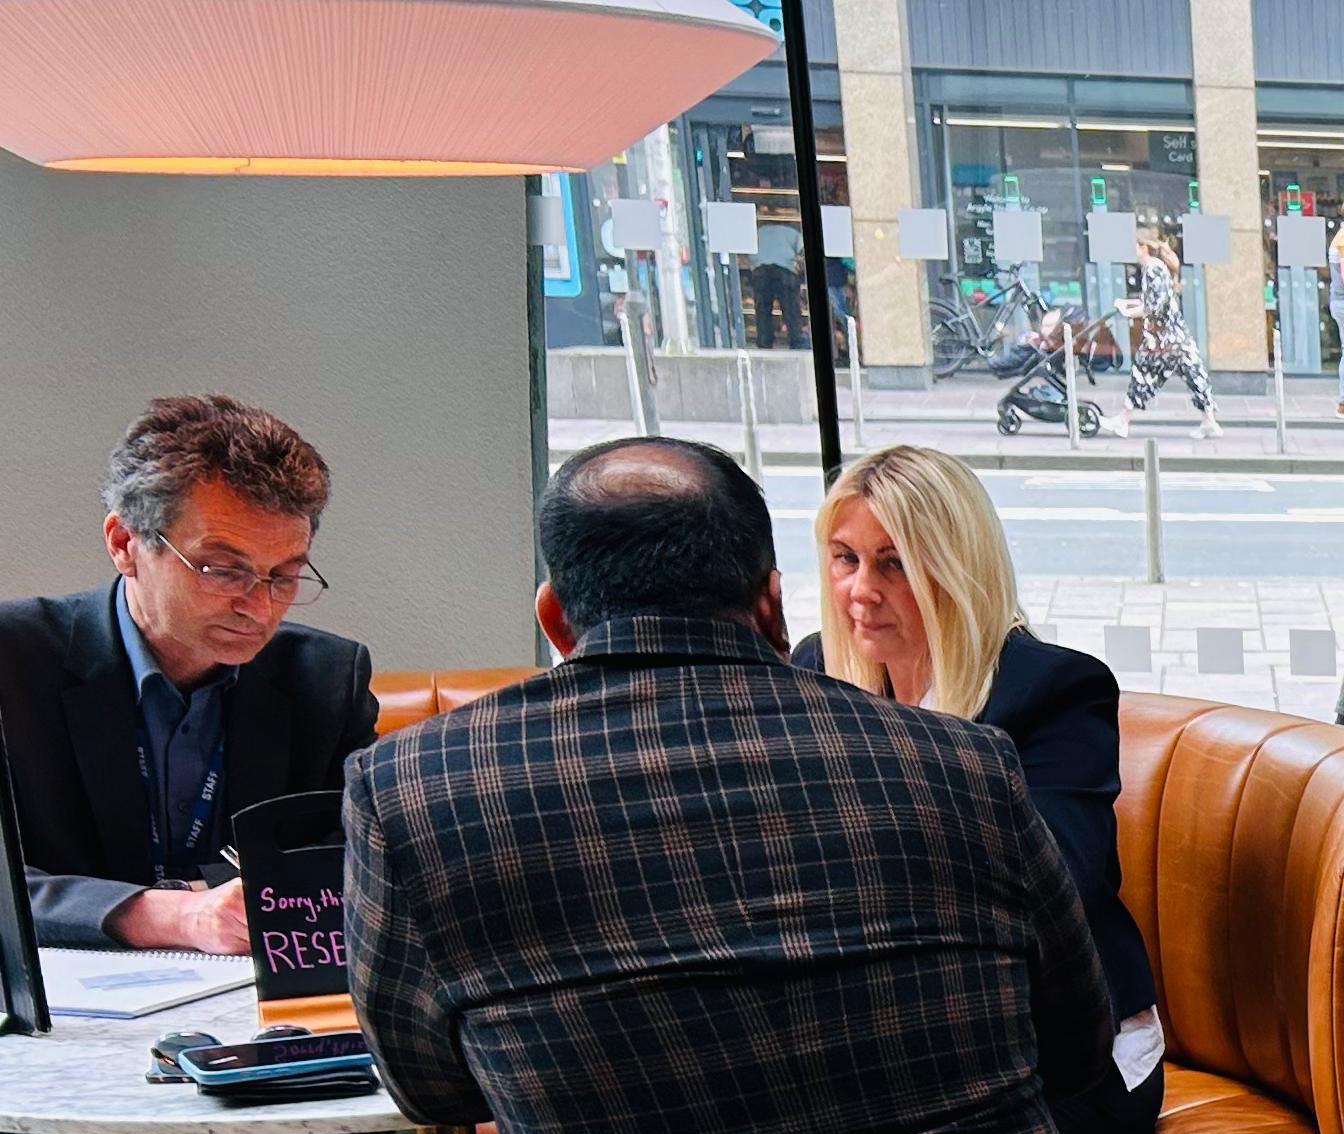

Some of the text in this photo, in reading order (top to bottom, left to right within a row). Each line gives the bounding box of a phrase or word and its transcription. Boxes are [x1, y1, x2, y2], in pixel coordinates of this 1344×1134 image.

[201, 769, 219, 801] STAFF
[186, 816, 205, 849] STAFF
[320, 888, 344, 909] thi
[262, 930, 347, 974] RESE
